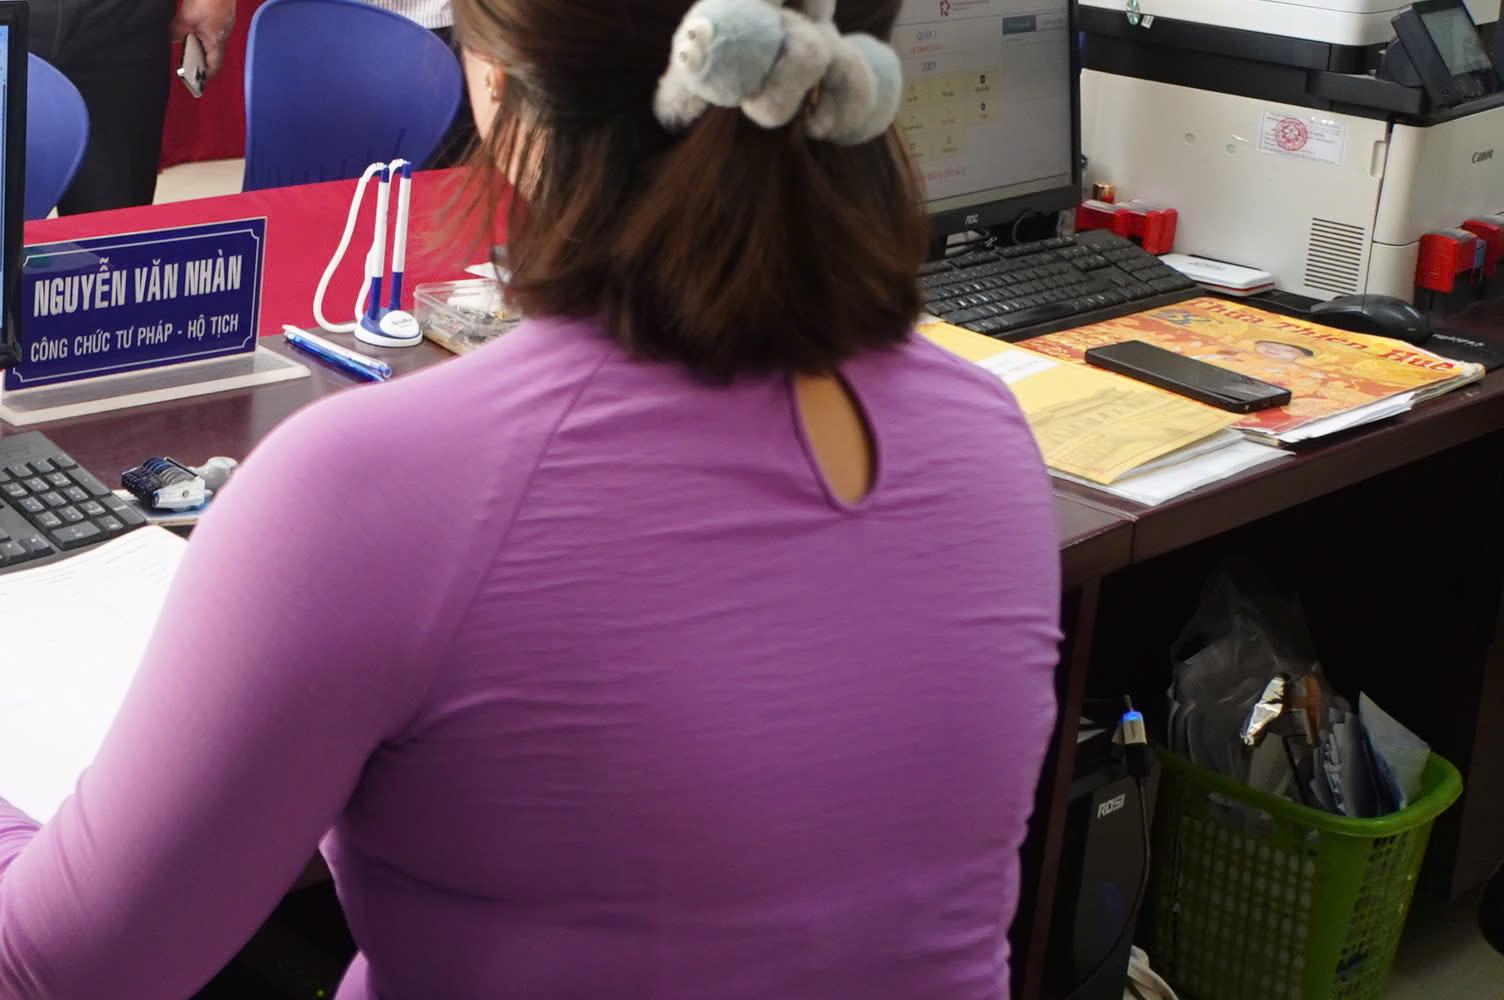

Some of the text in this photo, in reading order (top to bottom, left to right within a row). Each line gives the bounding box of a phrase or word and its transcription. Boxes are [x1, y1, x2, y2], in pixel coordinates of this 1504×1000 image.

[1471, 148, 1494, 165] Canon
[33, 248, 243, 318] NGUYỄN VĂN NHÀN
[30, 336, 68, 363] CÔNG
[73, 328, 111, 357] CHỨC
[115, 325, 135, 350] TƯ
[137, 319, 174, 347] PHÁP
[187, 314, 206, 345] HỘ
[210, 313, 239, 339] TỊCH
